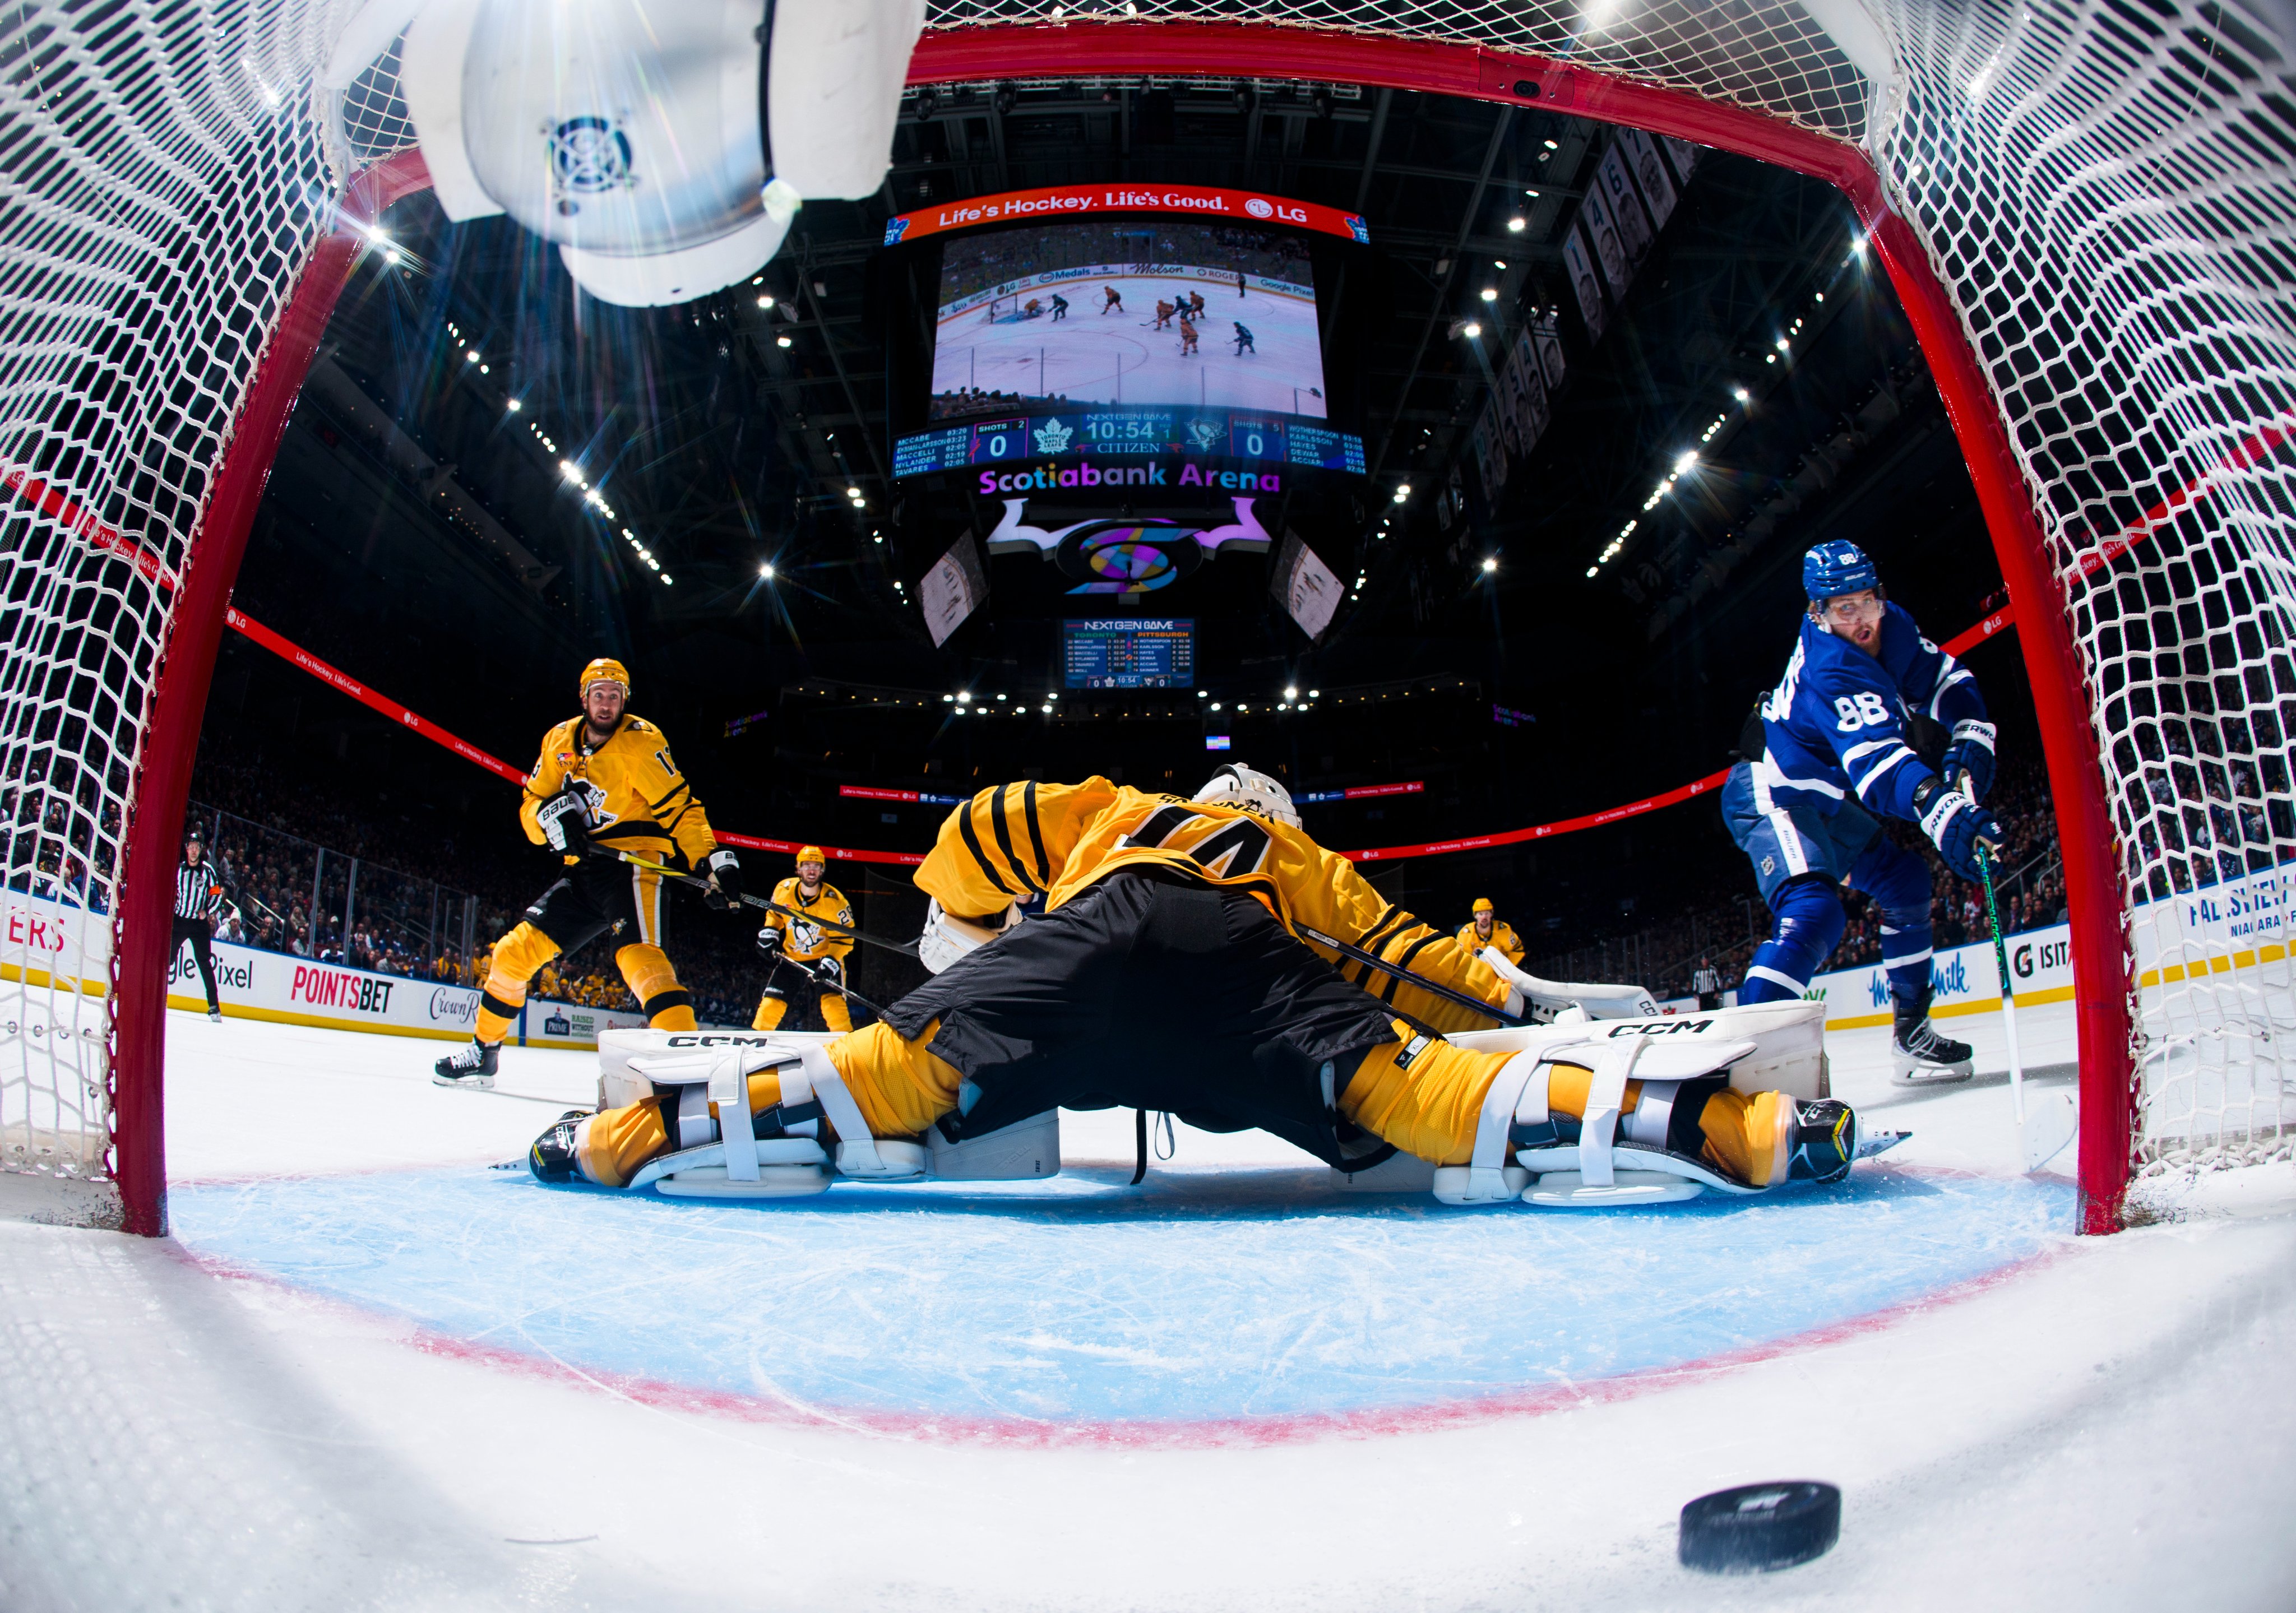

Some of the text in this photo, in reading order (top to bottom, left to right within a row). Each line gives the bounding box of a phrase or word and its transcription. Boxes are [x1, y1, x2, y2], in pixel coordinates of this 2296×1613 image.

[1608, 164, 1623, 195] 6
[939, 191, 1230, 227] Life's Hockey. Life's Good.
[1277, 205, 1307, 223] LG
[1055, 268, 1090, 279] Medals
[1129, 263, 1184, 275] Molson
[1209, 270, 1239, 281] ROGER
[1005, 282, 1016, 294] LG
[1260, 279, 1314, 297] Google Pixel
[978, 420, 1025, 433] SHOTS 2
[1086, 421, 1155, 440] 10:54
[1233, 420, 1263, 430] SHOTS
[898, 434, 931, 446] MCCABE
[1164, 429, 1170, 439] 1
[1289, 433, 1333, 446] KARLSSON
[989, 435, 1007, 457] 0
[1097, 443, 1160, 454] CITIZEN
[1246, 434, 1263, 456] 0
[1290, 441, 1316, 451] HAYES
[896, 448, 935, 462] MACCELLI
[1290, 448, 1320, 458] DEWAR
[895, 455, 937, 470] NYLANDER
[895, 465, 929, 477] TAVARES
[979, 461, 1280, 495] Scotiabank Arena
[1838, 553, 1858, 566] 88
[236, 615, 247, 629] LG
[1144, 620, 1173, 630] GAME
[1992, 616, 2002, 628] LG
[296, 651, 312, 668] Life's
[312, 660, 334, 680] Hockey.
[1834, 691, 1890, 732] 88
[410, 716, 418, 726] LG
[543, 795, 575, 822] BAUE
[291, 965, 394, 1013] POINTSBET
[430, 986, 467, 1021] Crown
[1638, 1000, 1659, 1016] CC
[571, 1014, 594, 1023] RAISED
[547, 1021, 568, 1033] PRIME
[571, 1023, 594, 1032] WITHOUT
[1608, 1019, 1715, 1039] CCM
[668, 1036, 768, 1048] CCM
